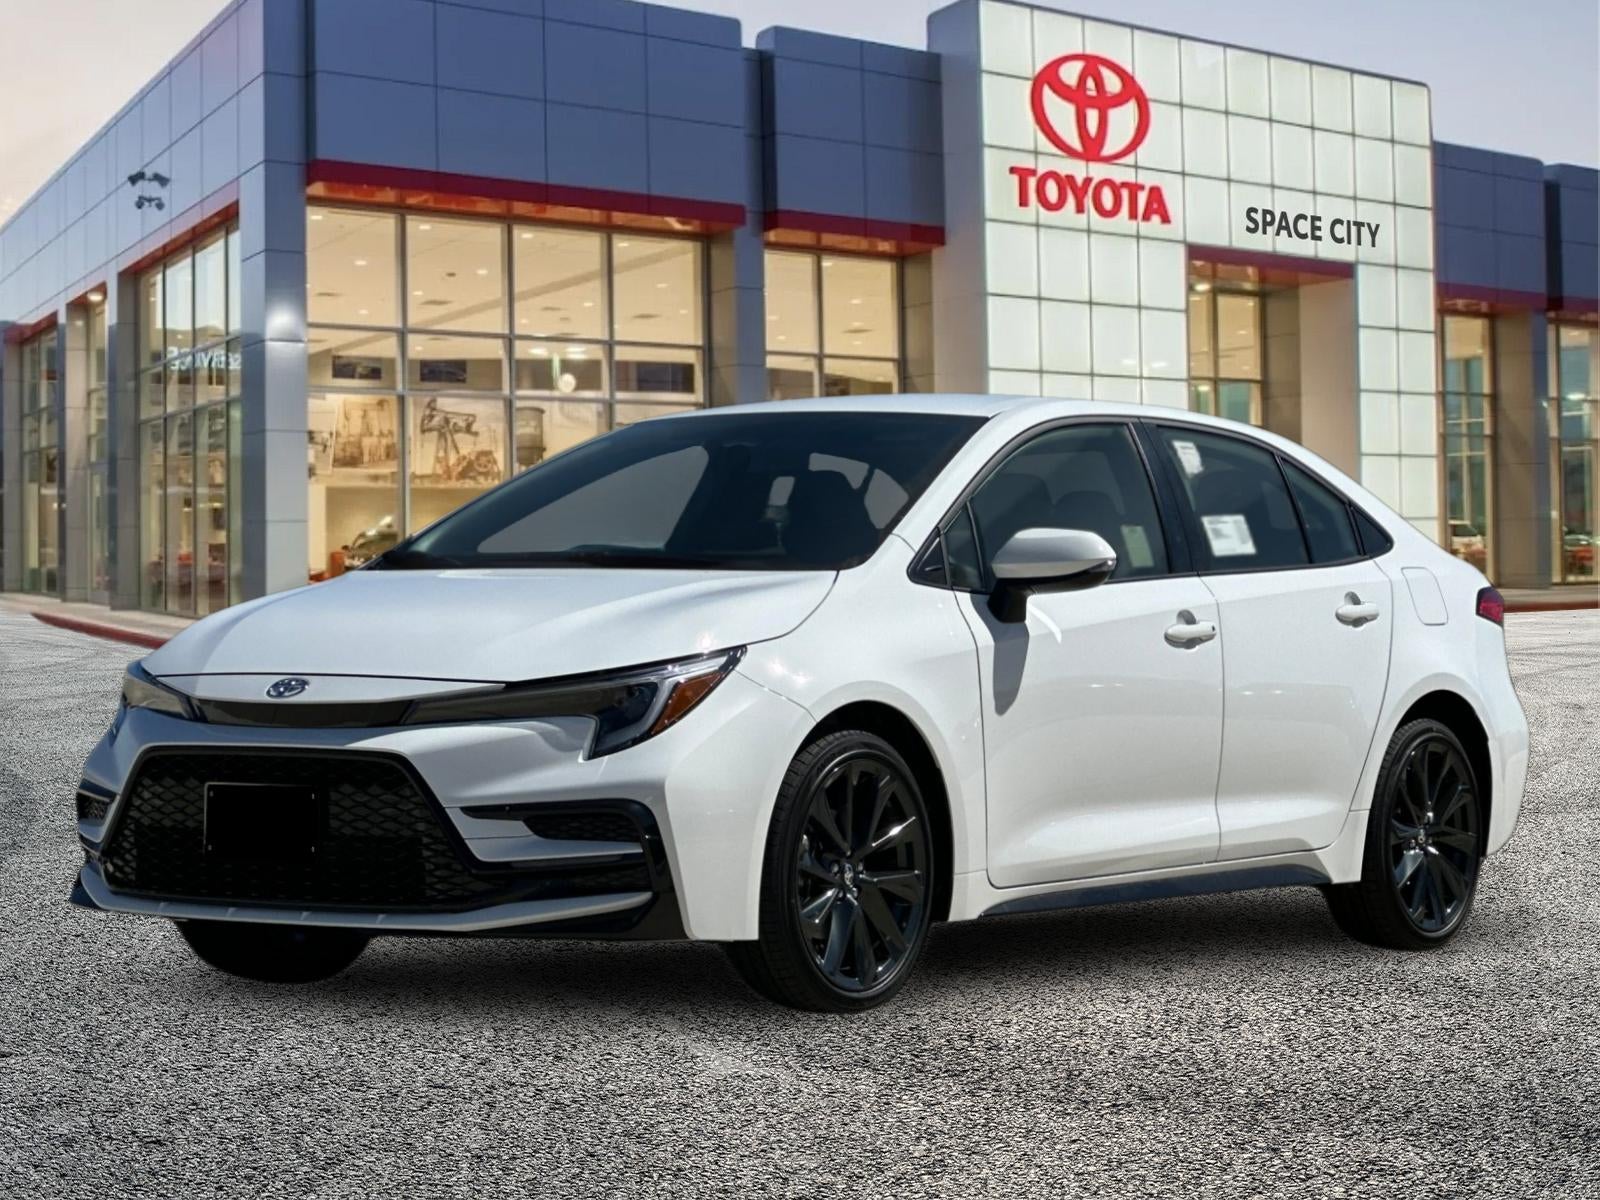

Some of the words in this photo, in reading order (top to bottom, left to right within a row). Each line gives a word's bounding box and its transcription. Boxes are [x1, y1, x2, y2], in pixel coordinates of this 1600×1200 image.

[1009, 166, 1171, 225] TOYOTA
[1245, 206, 1322, 242] SPACE
[1329, 217, 1381, 248] CITY
